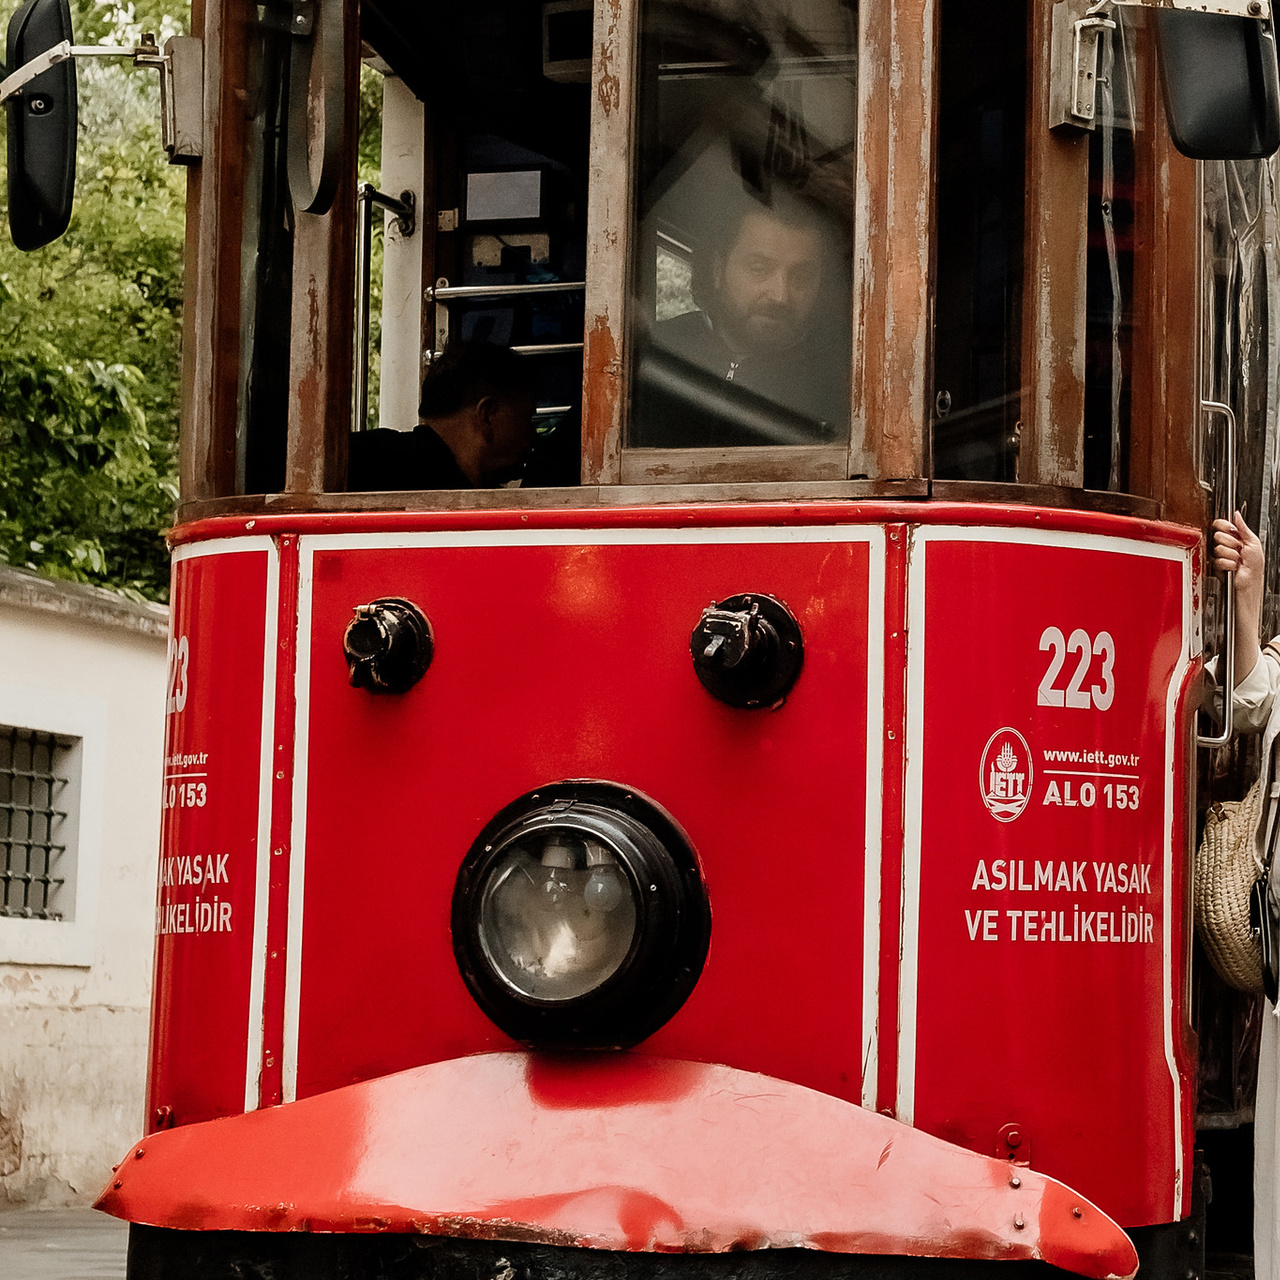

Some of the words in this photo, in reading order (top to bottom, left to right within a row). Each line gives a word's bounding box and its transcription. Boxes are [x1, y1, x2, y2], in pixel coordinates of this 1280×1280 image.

[1037, 626, 1116, 712] 223
[1043, 749, 1140, 768] www.iett.gov.tr
[179, 782, 207, 808] 153
[1042, 780, 1096, 808] ALO
[1103, 783, 1140, 811] 153
[177, 853, 230, 887] YASAK
[971, 859, 1087, 892] ASILMAK
[1092, 862, 1151, 894] YASAK
[964, 909, 999, 941] VE
[1006, 903, 1154, 943] TEHLİKELİDİR
